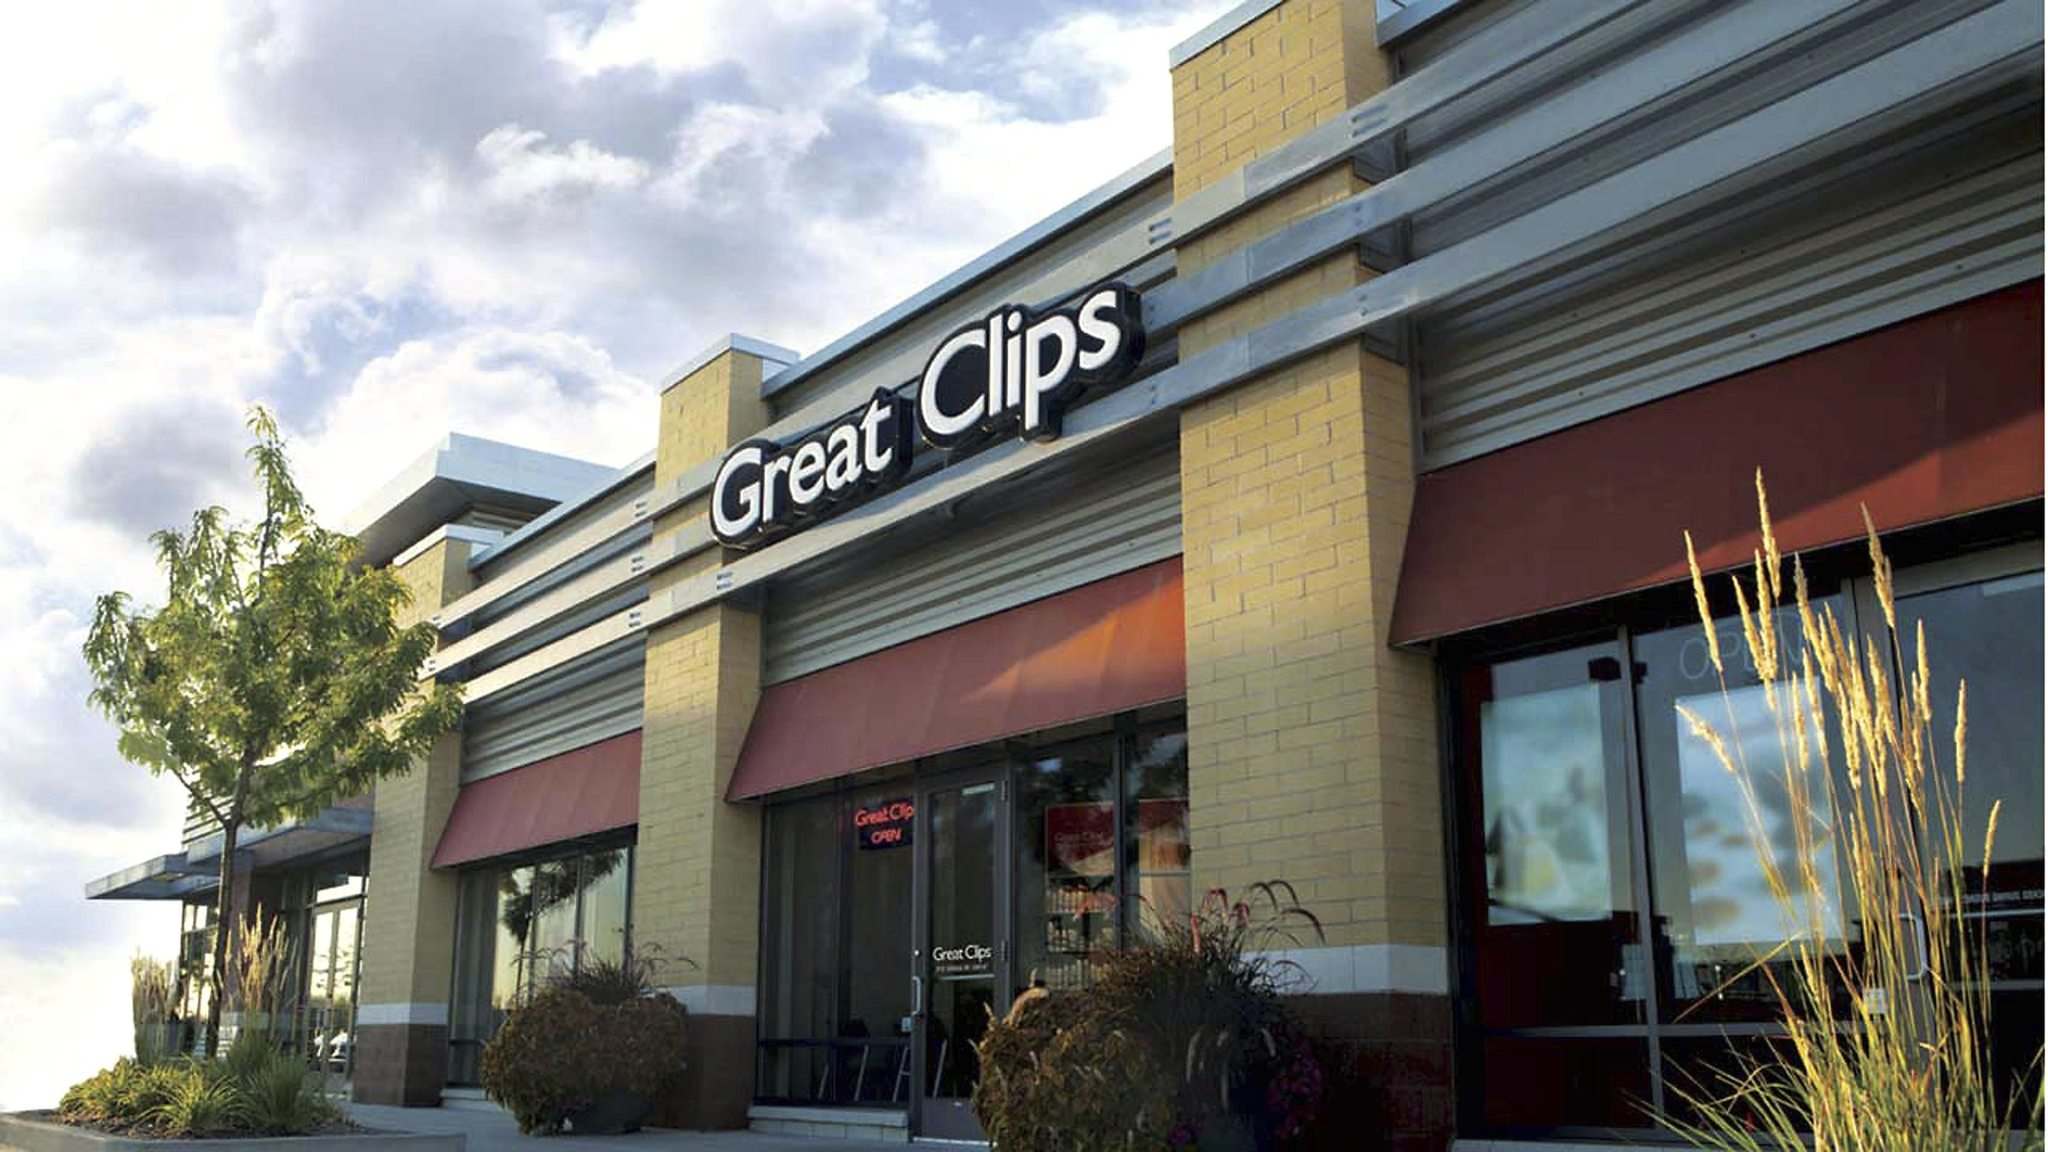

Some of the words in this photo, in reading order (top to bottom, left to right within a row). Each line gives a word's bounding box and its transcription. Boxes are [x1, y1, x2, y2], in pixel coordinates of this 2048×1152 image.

[712, 400, 893, 537] Great
[920, 290, 1122, 435] Clips
[855, 807, 889, 827] Great
[889, 802, 914, 821] Clip
[871, 827, 902, 844] OPEN
[932, 946, 963, 961] Great
[964, 944, 992, 962] Clips
